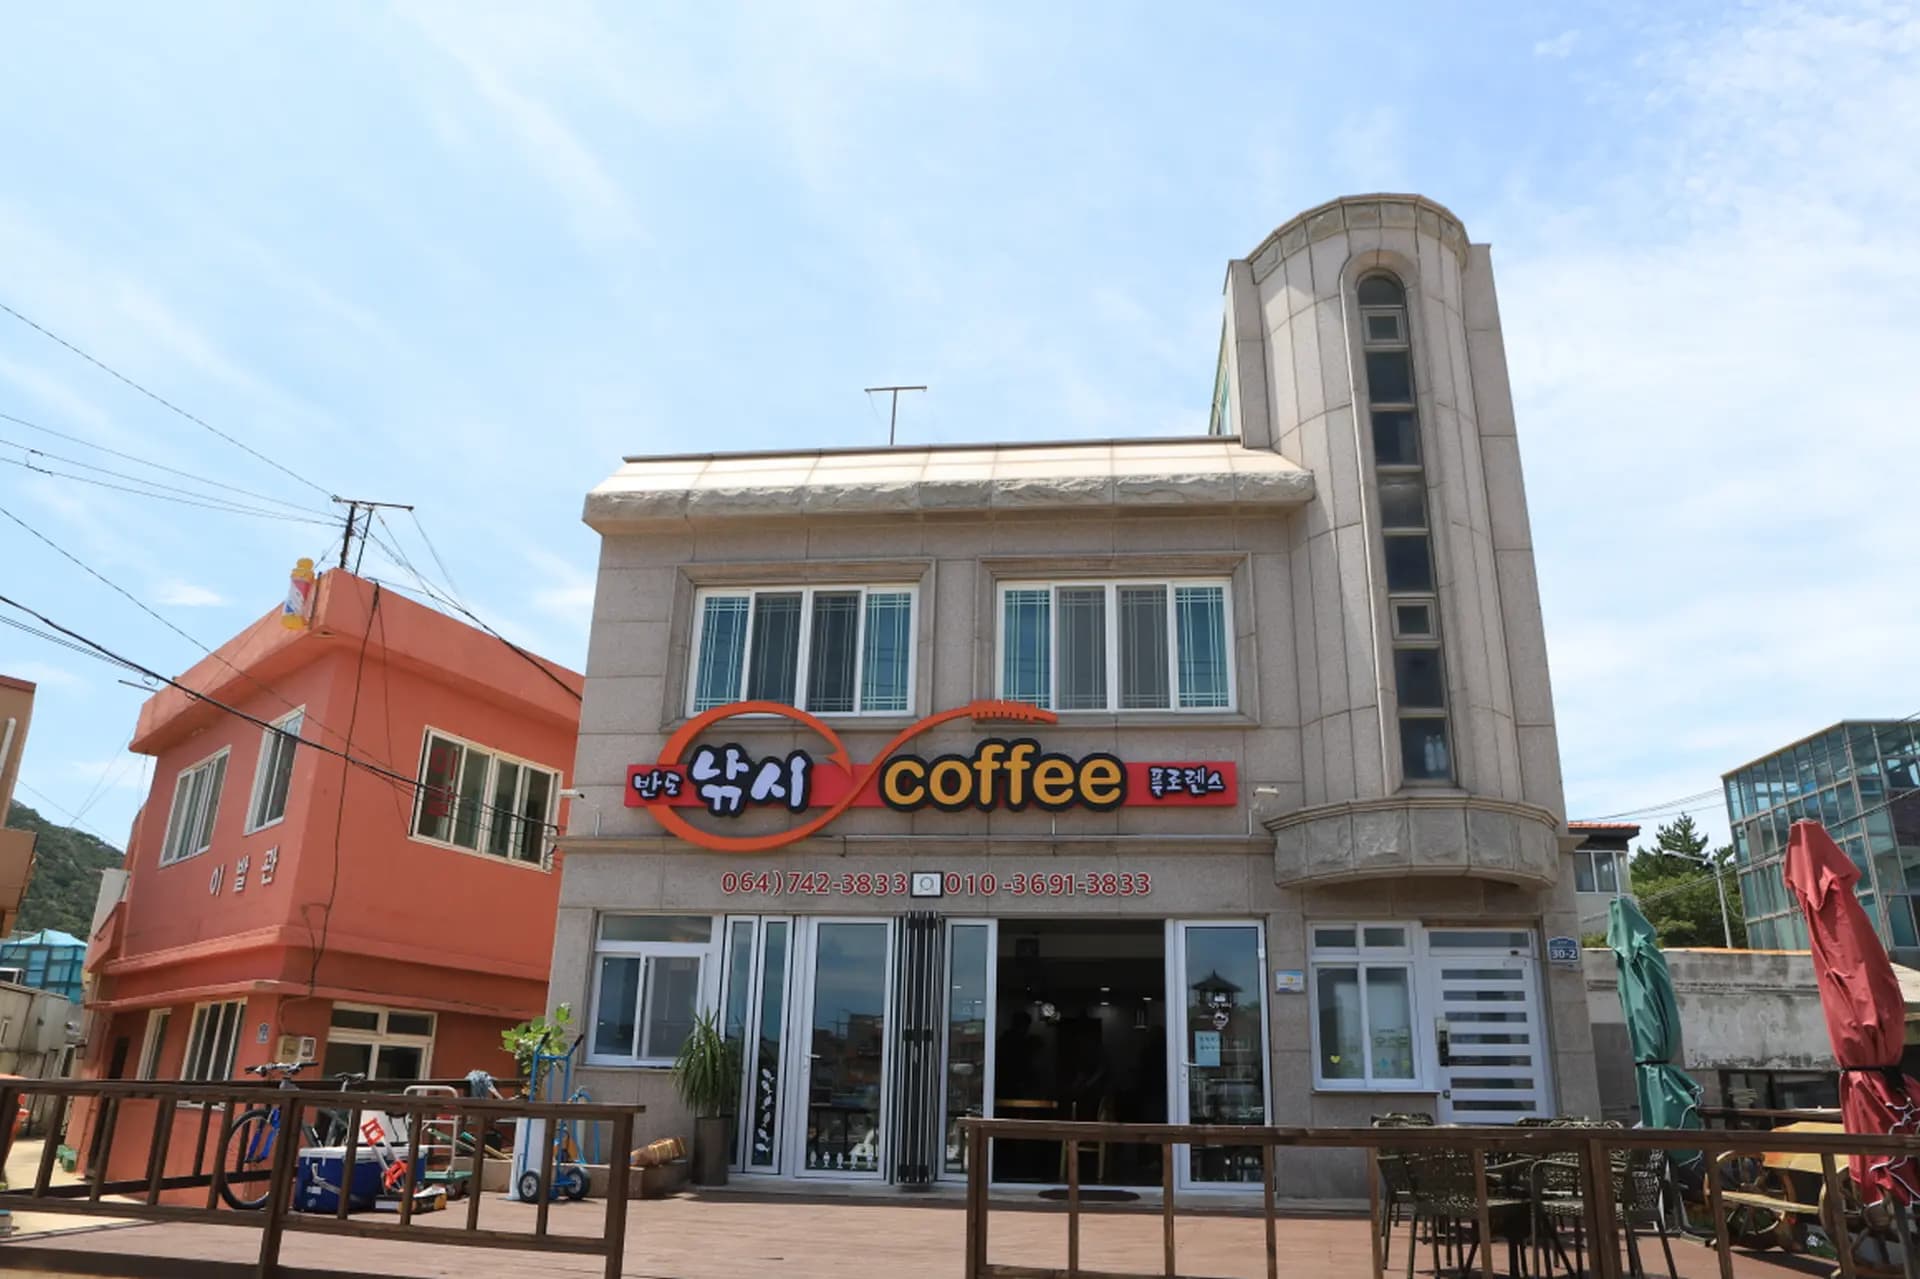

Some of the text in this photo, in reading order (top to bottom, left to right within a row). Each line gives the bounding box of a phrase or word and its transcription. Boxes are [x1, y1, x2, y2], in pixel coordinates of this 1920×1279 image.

[633, 771, 682, 797] 반도
[691, 748, 808, 812] 낚시
[883, 743, 1122, 805] coffee
[721, 871, 908, 896] 064)742-3833
[1551, 949, 1577, 960] 30-2
